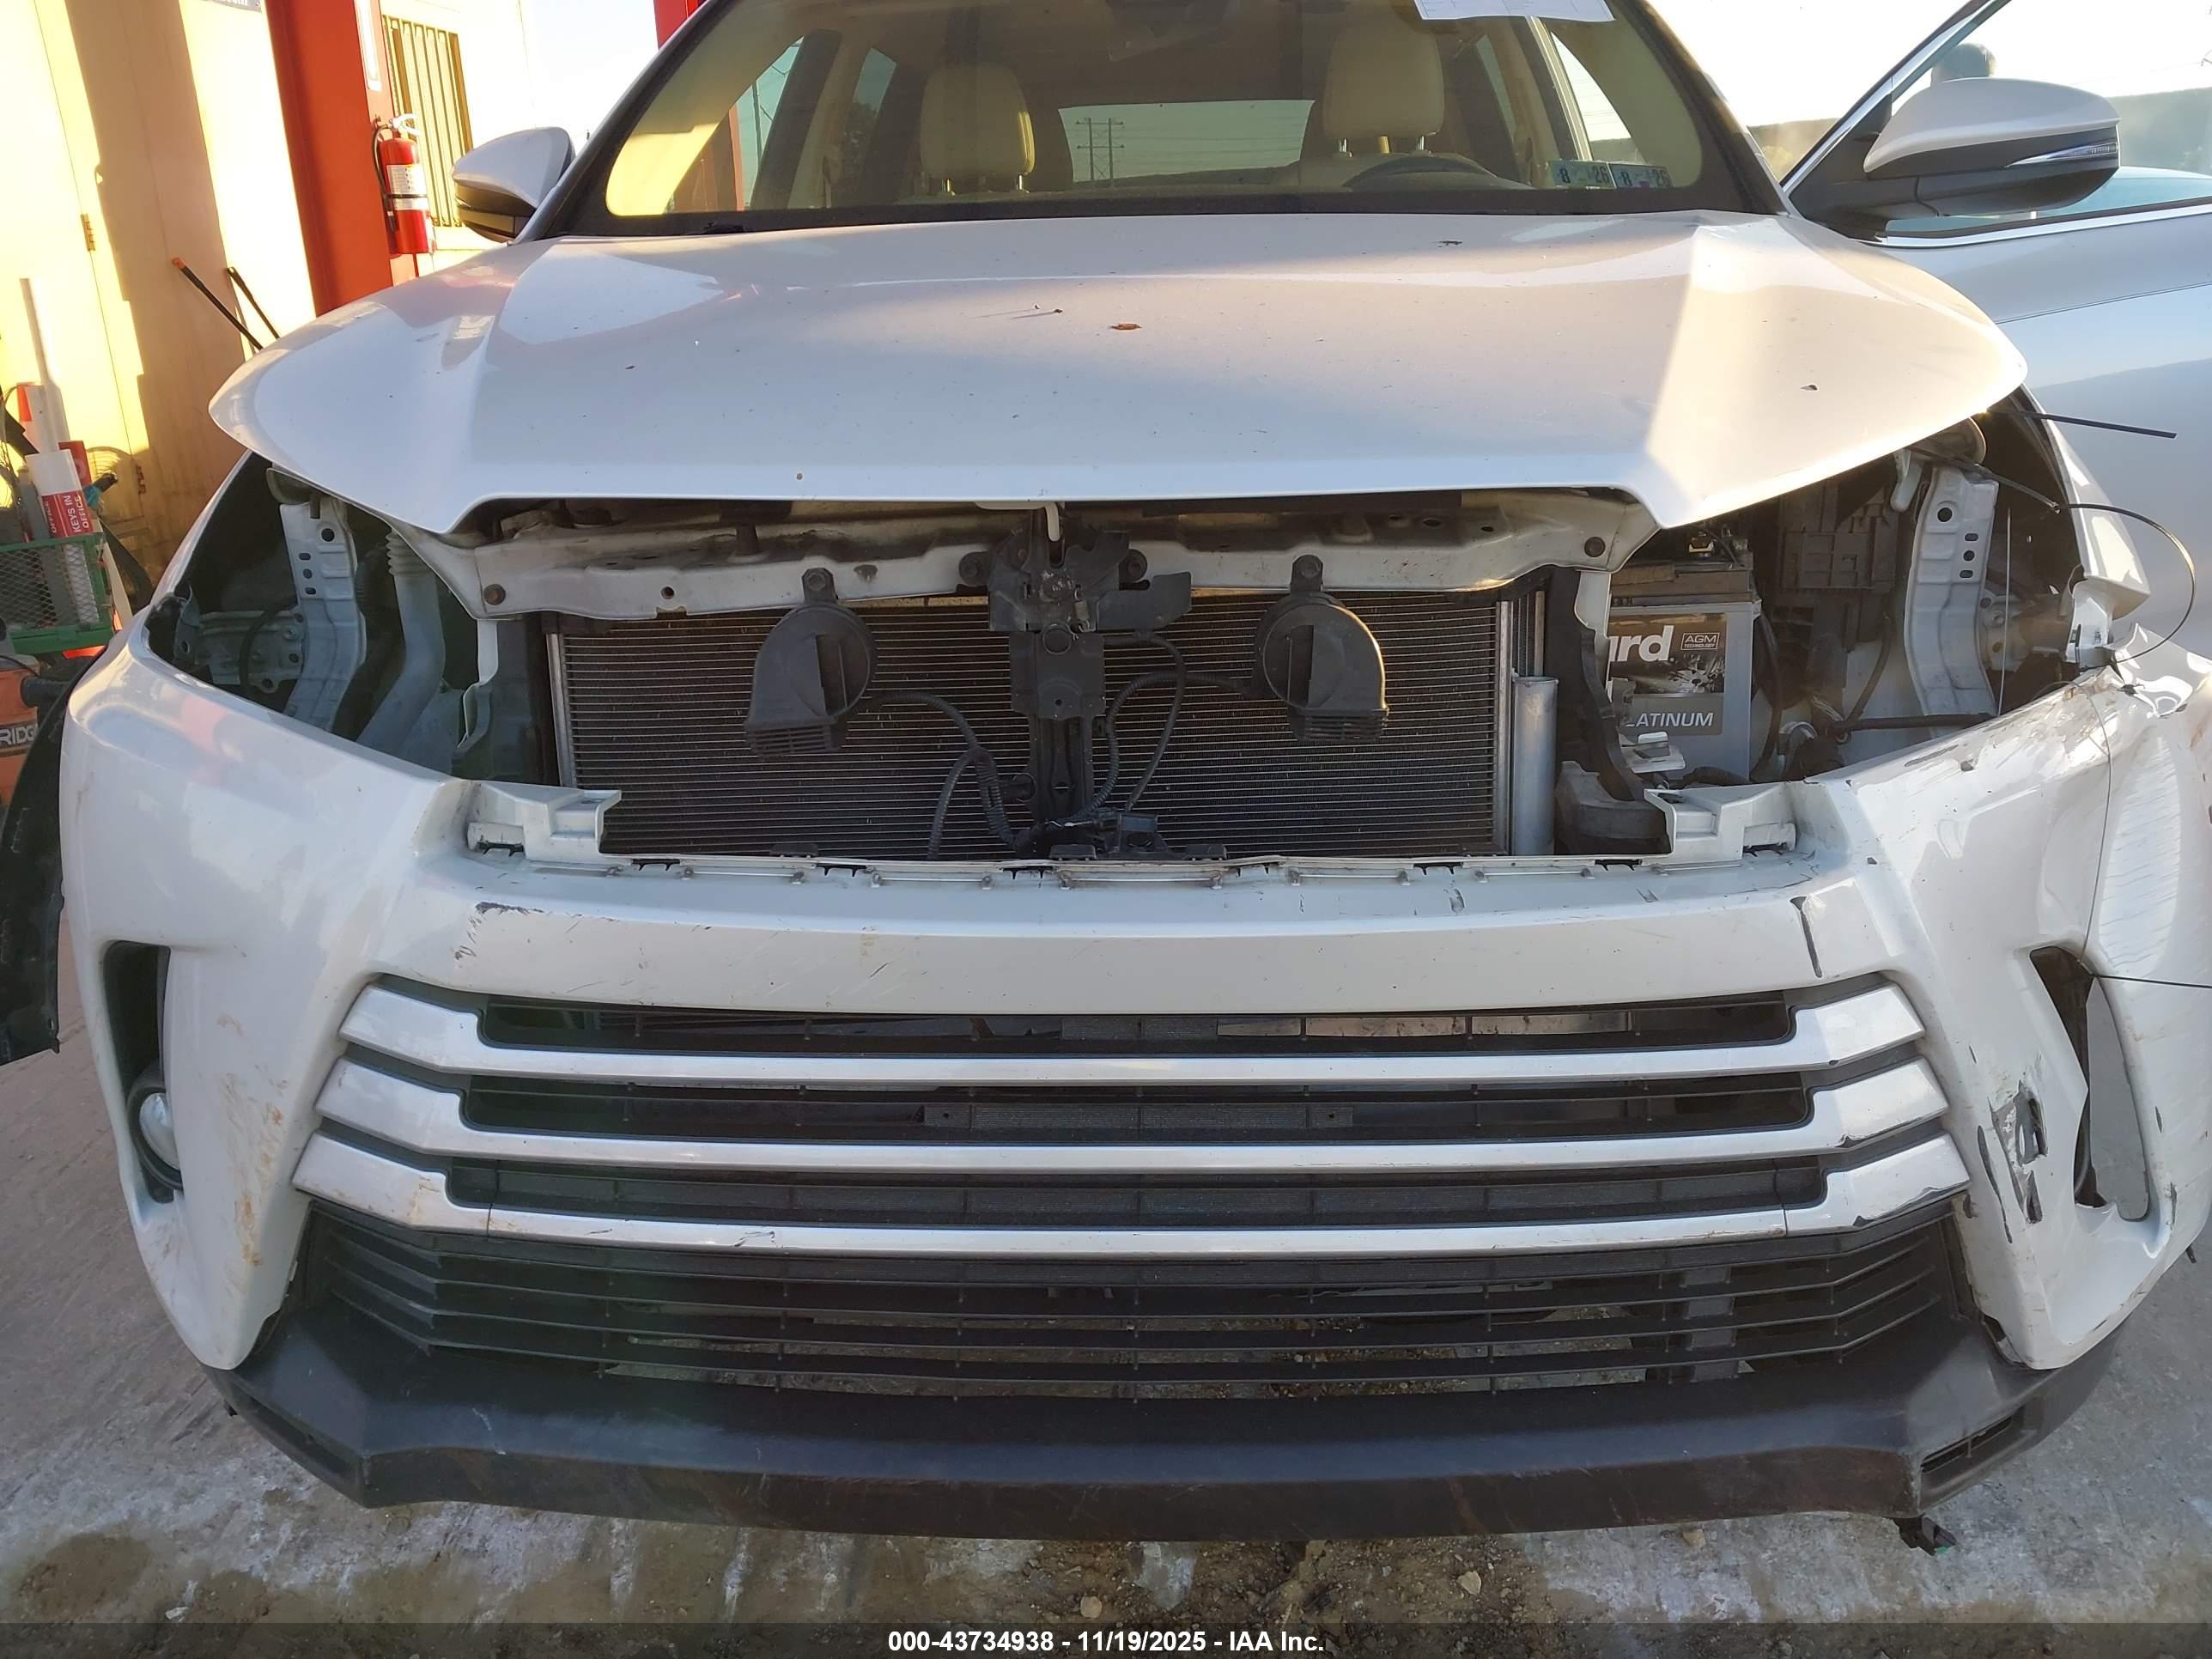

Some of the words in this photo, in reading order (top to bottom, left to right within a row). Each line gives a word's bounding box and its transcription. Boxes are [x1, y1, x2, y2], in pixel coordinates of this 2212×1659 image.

[64, 495, 74, 506] IN
[67, 507, 82, 532] KEYS
[75, 494, 89, 529] OFFICE
[1684, 635, 1717, 643] AGM
